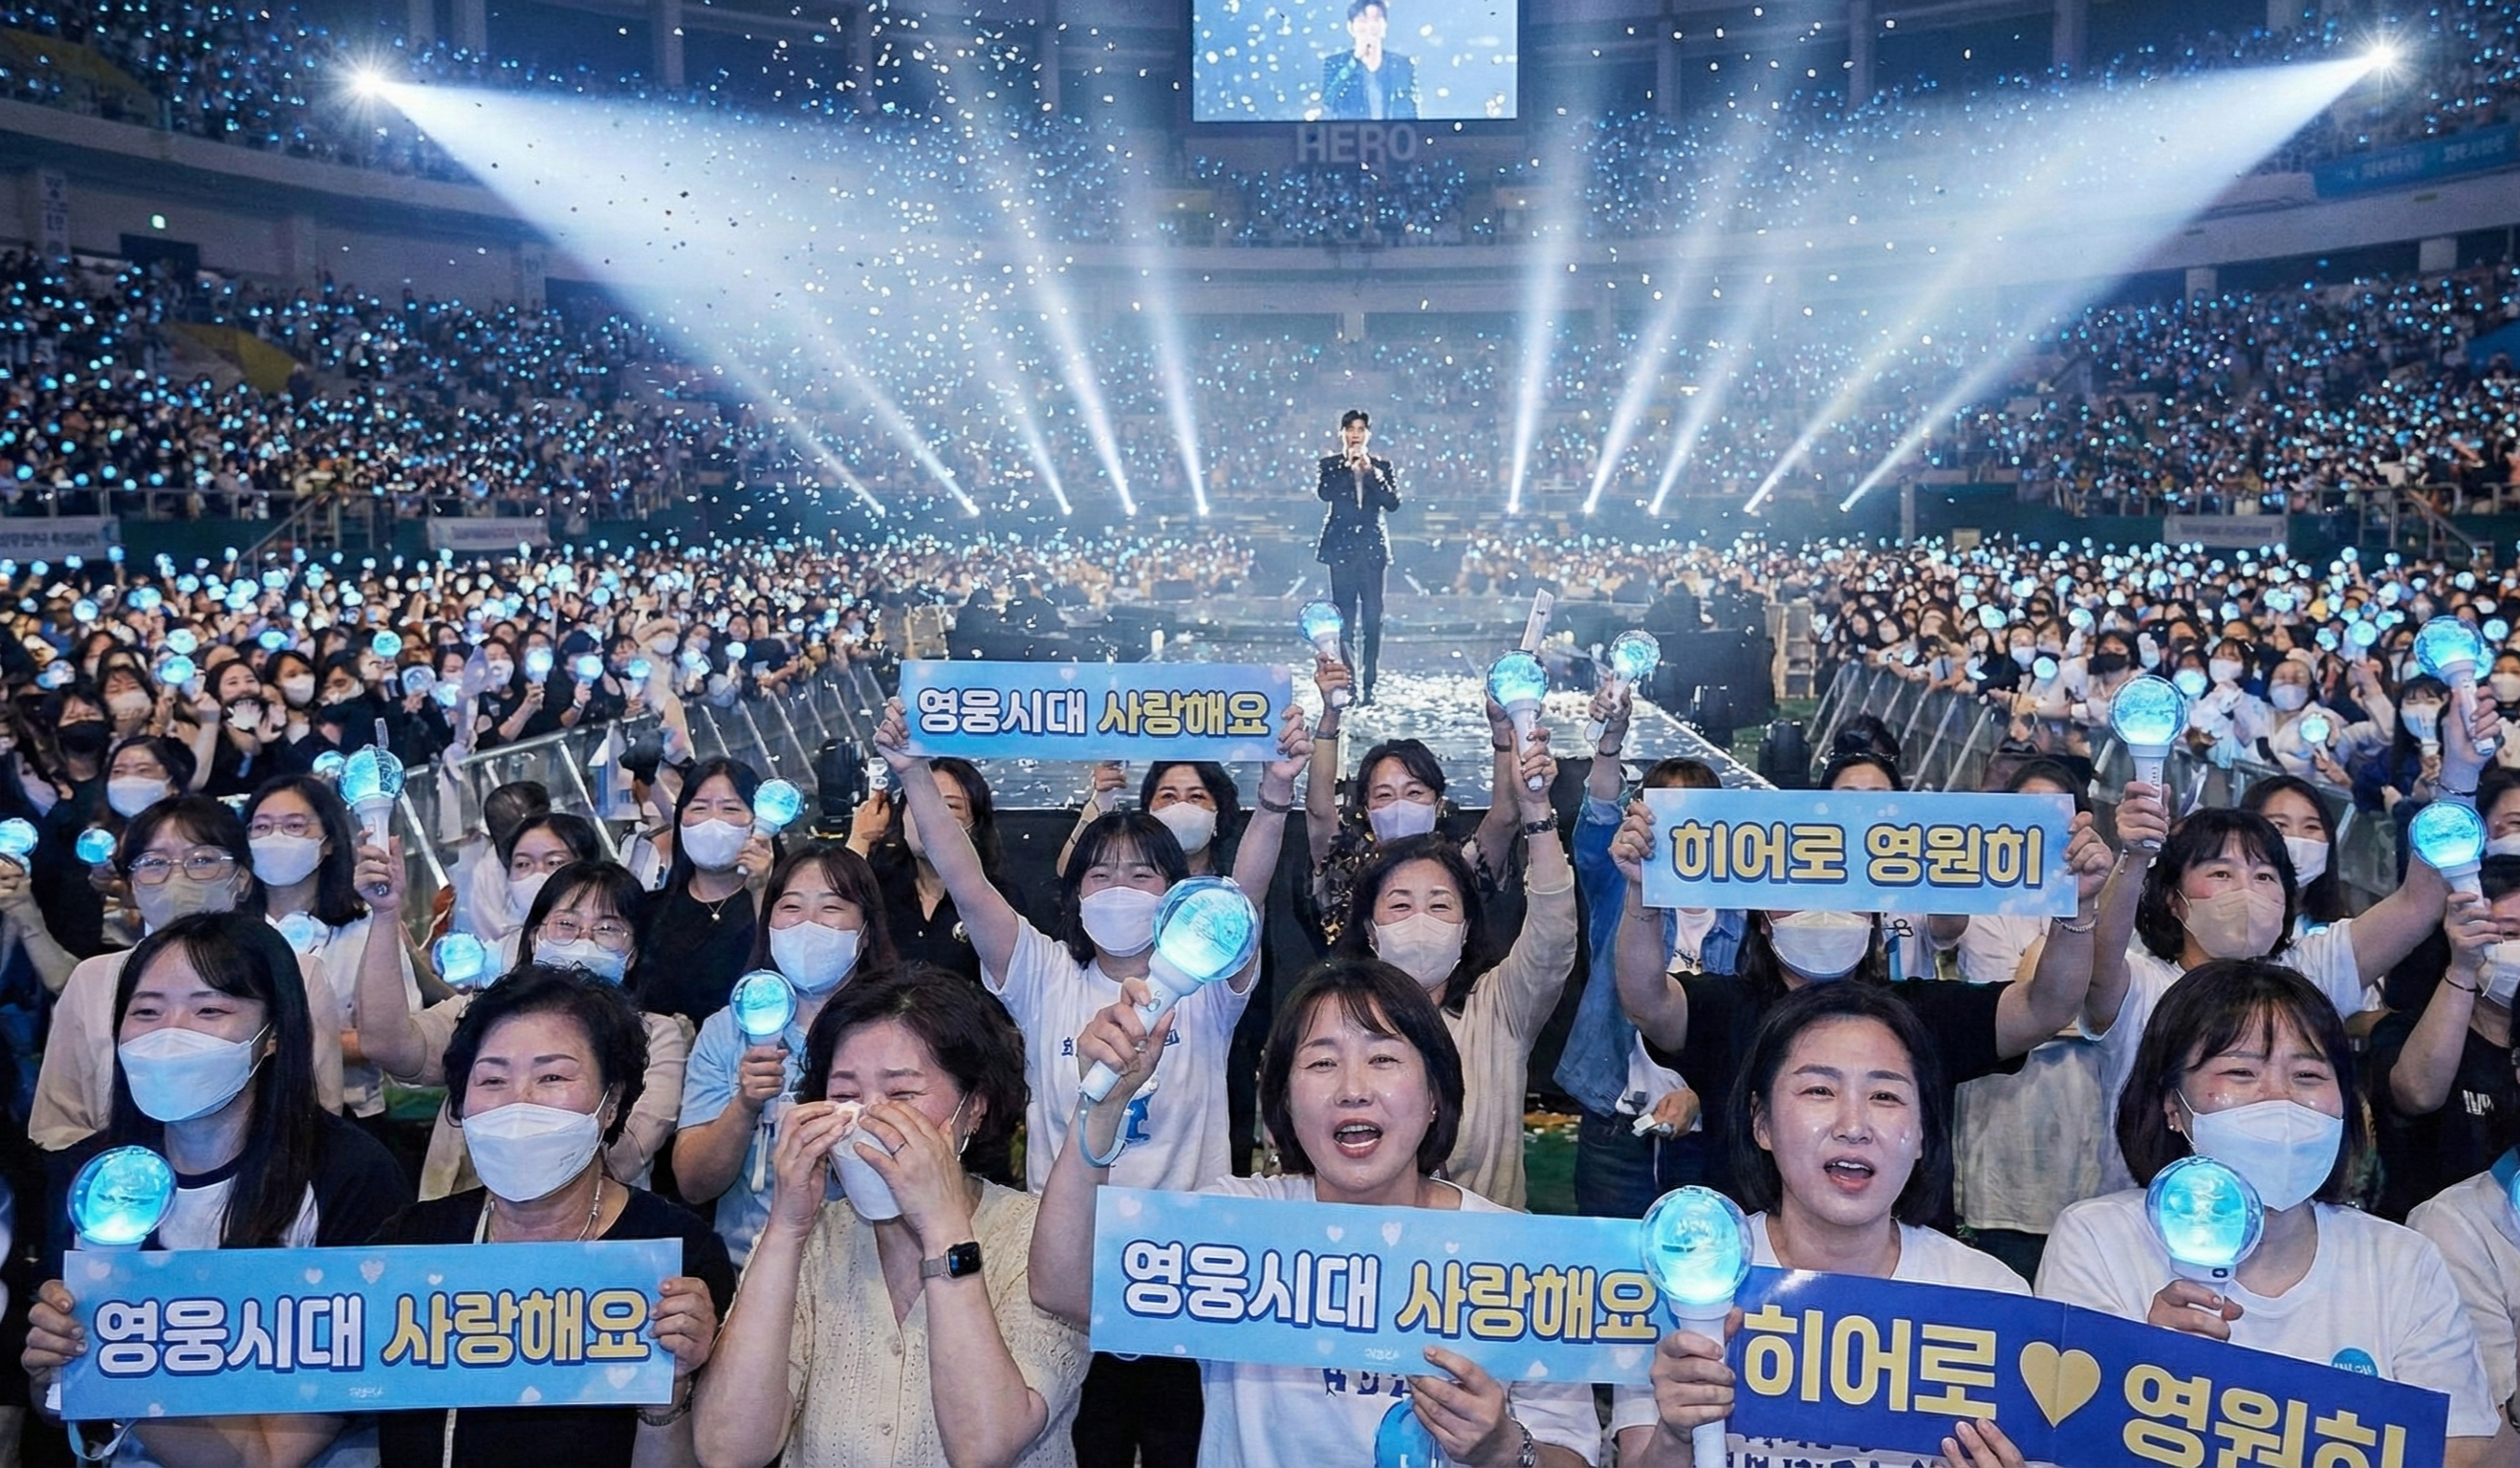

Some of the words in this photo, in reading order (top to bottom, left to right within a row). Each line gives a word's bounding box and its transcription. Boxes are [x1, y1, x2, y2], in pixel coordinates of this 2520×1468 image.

[1296, 122, 1417, 163] HERO
[917, 688, 1088, 736] 영웅시대
[1097, 688, 1272, 738] 사랑해요
[1669, 818, 1847, 885] 히어로
[1865, 822, 2044, 888] 영원히
[94, 1292, 364, 1377] 영웅시대
[381, 1287, 652, 1367] 사랑해요
[1121, 1241, 1382, 1331] 영웅시대
[1395, 1257, 1662, 1344] 사랑해요
[1744, 1304, 1997, 1421] 히어로
